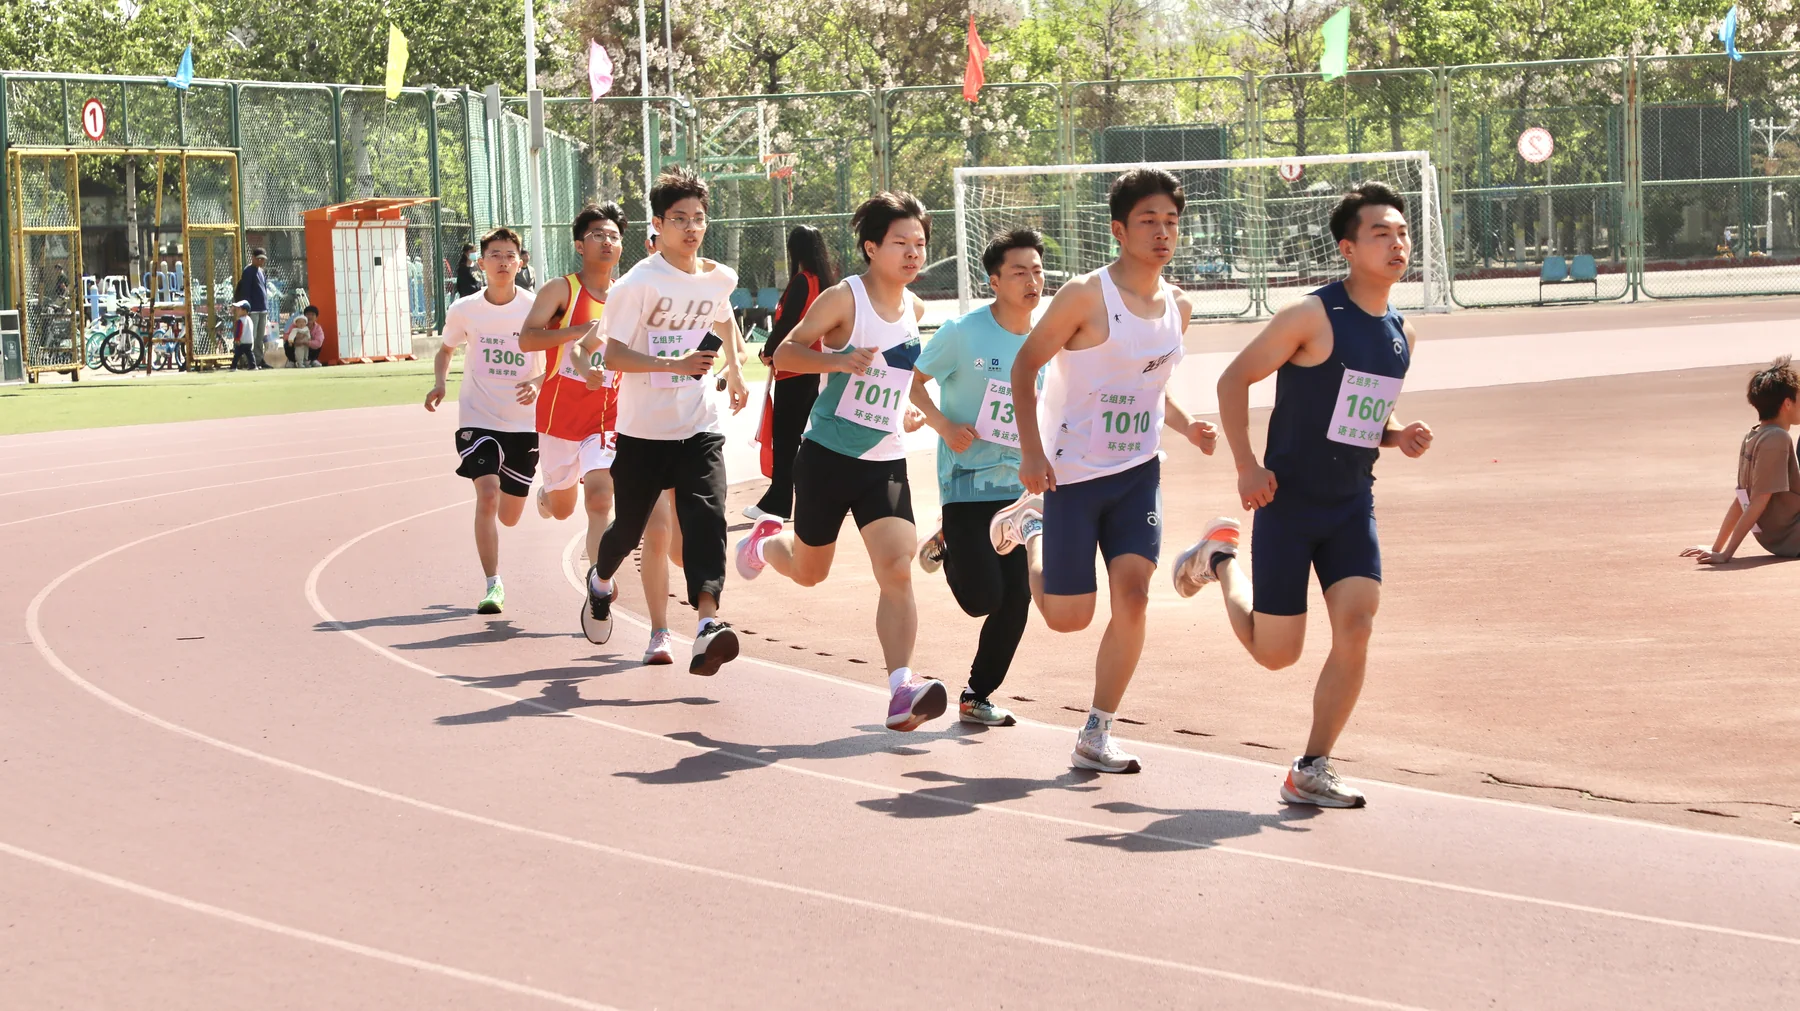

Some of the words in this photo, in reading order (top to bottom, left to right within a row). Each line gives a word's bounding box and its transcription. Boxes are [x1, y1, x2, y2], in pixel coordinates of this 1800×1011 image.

[89, 107, 97, 132] 1
[480, 336, 506, 346] 乙组男子
[652, 335, 683, 344] 乙组男子
[482, 348, 526, 367] 1306
[488, 367, 518, 377] 海运学院
[865, 366, 887, 379] 组男子
[1347, 374, 1380, 388] 乙组男子
[854, 380, 901, 411] 1011
[990, 383, 1012, 396] 乙组男
[1100, 393, 1136, 405] 乙组男子
[854, 408, 890, 426] 环安学院
[990, 400, 1015, 424] 13
[1102, 410, 1150, 434] 1010
[992, 428, 1020, 442] 海运学
[1108, 441, 1141, 452] 环安学院
